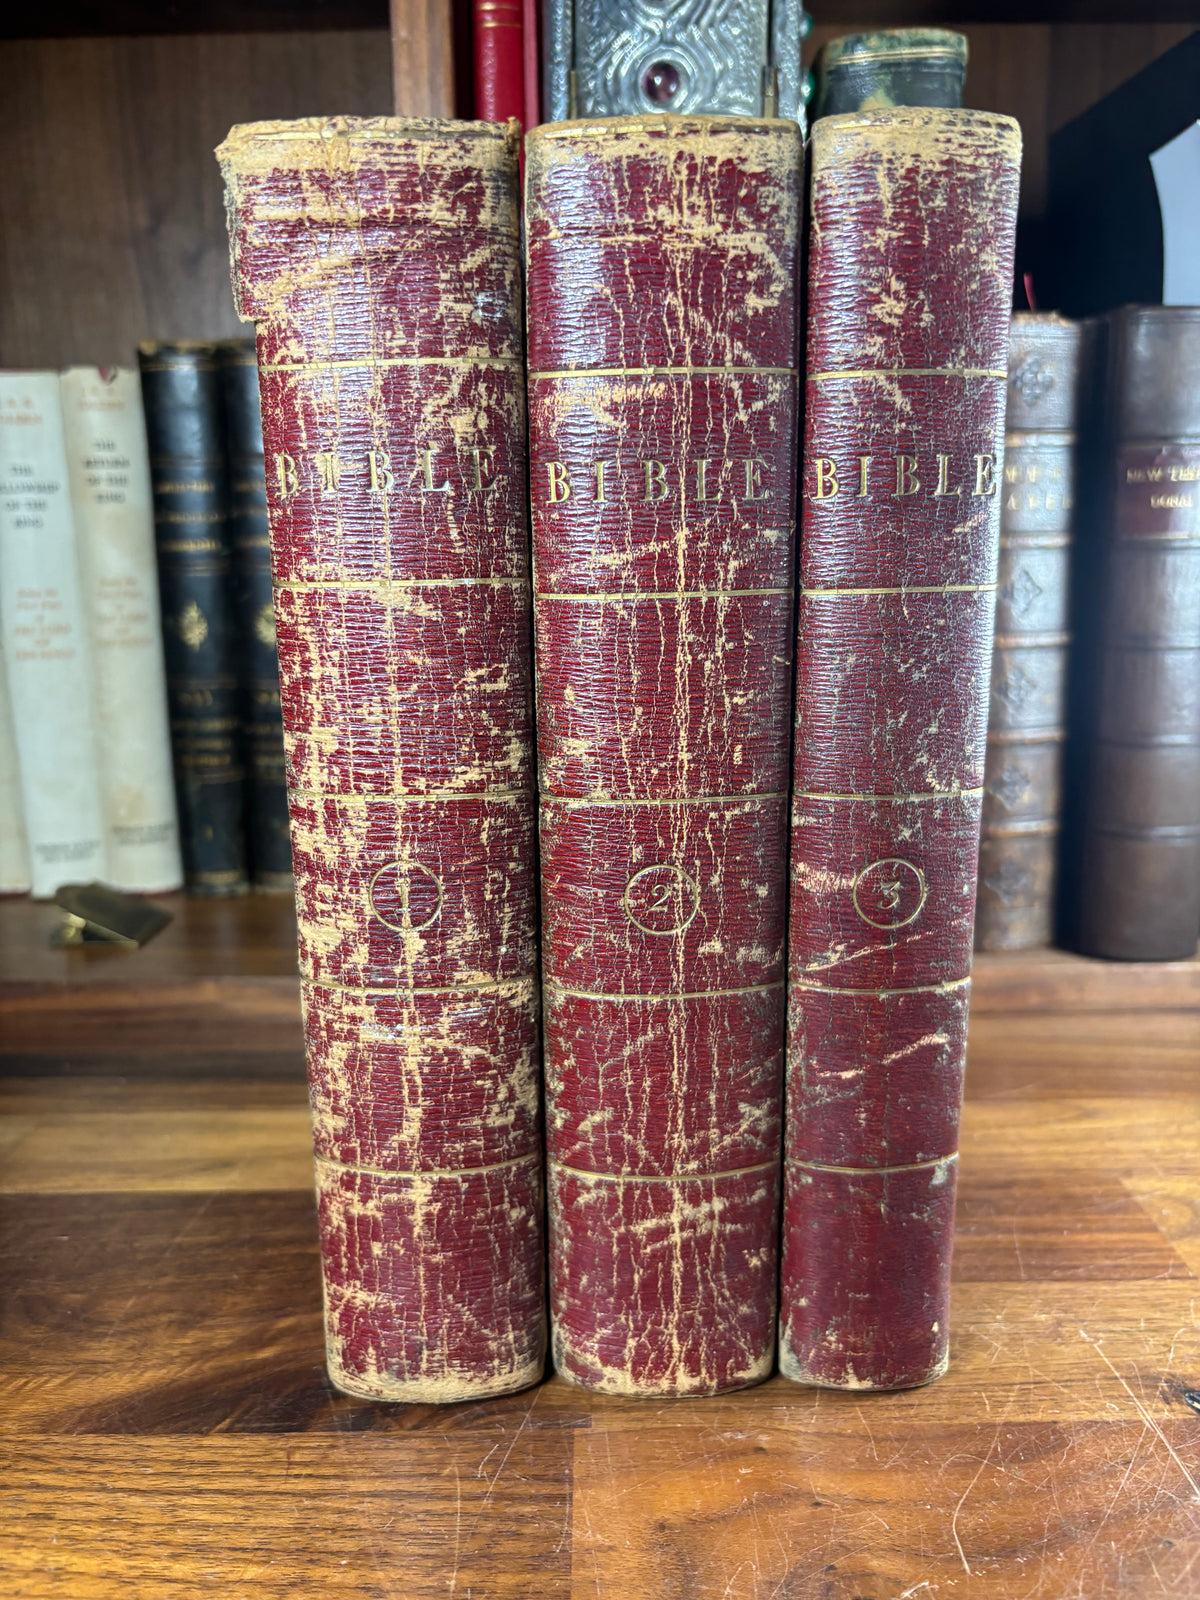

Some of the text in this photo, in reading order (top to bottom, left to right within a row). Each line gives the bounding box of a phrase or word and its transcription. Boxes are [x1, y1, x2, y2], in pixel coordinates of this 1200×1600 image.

[277, 449, 497, 496] BIBLE
[546, 457, 771, 504] BIBLE
[813, 453, 997, 500] BIBLE
[648, 884, 669, 912] 2
[877, 881, 900, 910] 3
